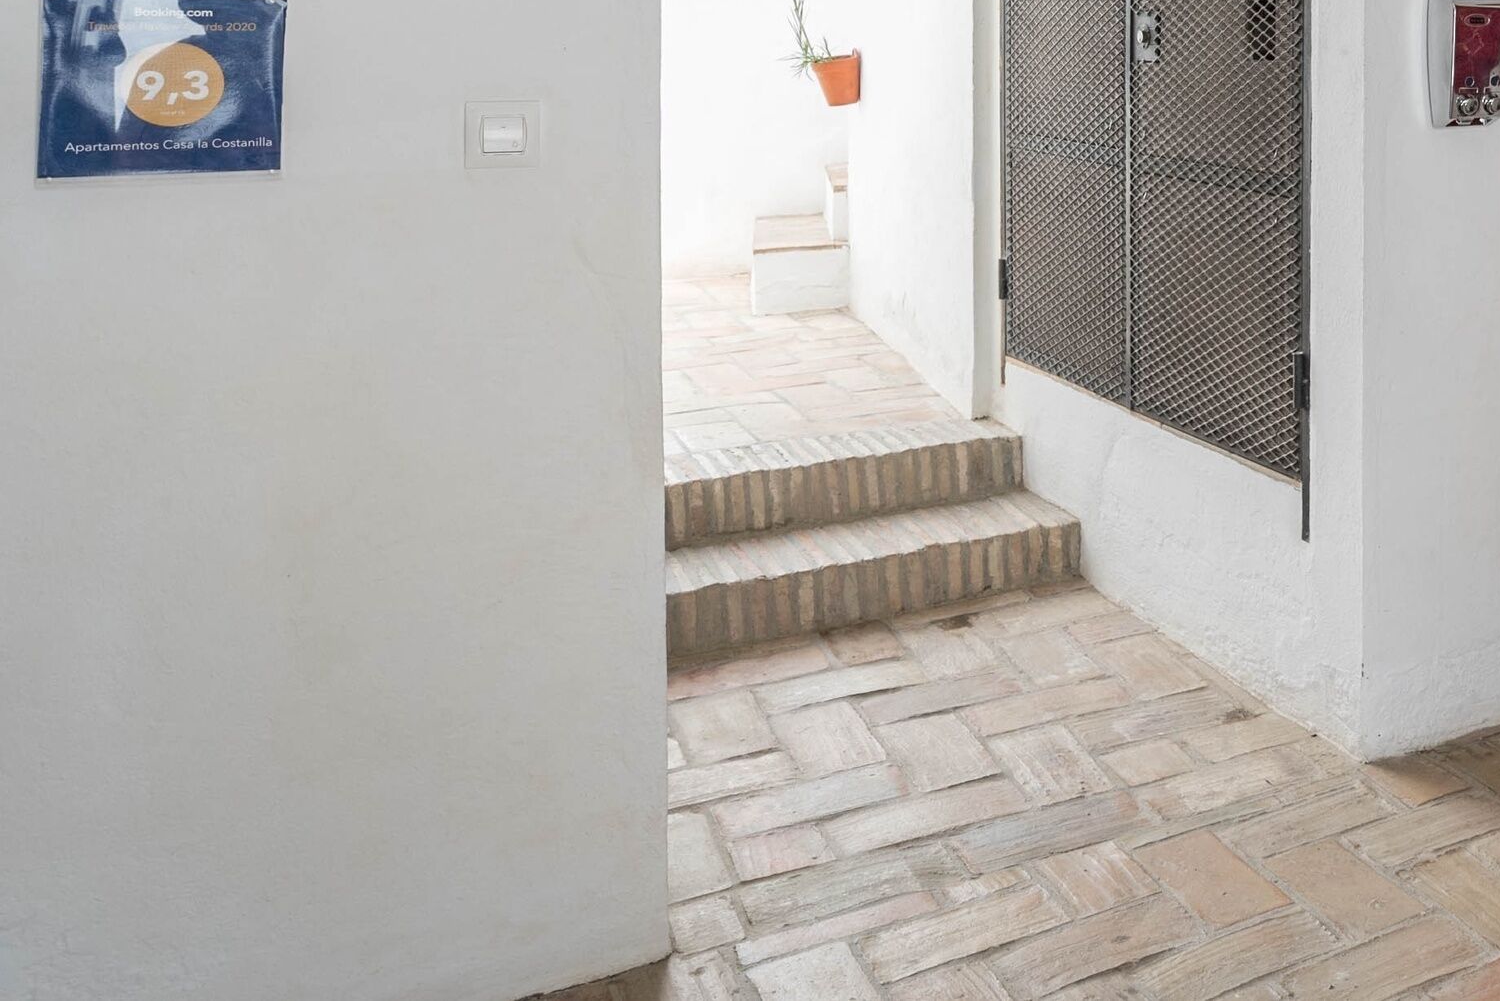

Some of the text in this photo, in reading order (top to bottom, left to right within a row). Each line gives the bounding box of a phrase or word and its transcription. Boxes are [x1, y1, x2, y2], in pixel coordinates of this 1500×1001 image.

[226, 22, 256, 32] 2020
[136, 70, 209, 105] 9,3
[64, 137, 273, 155] Apartamentos Casa la Costanilla
